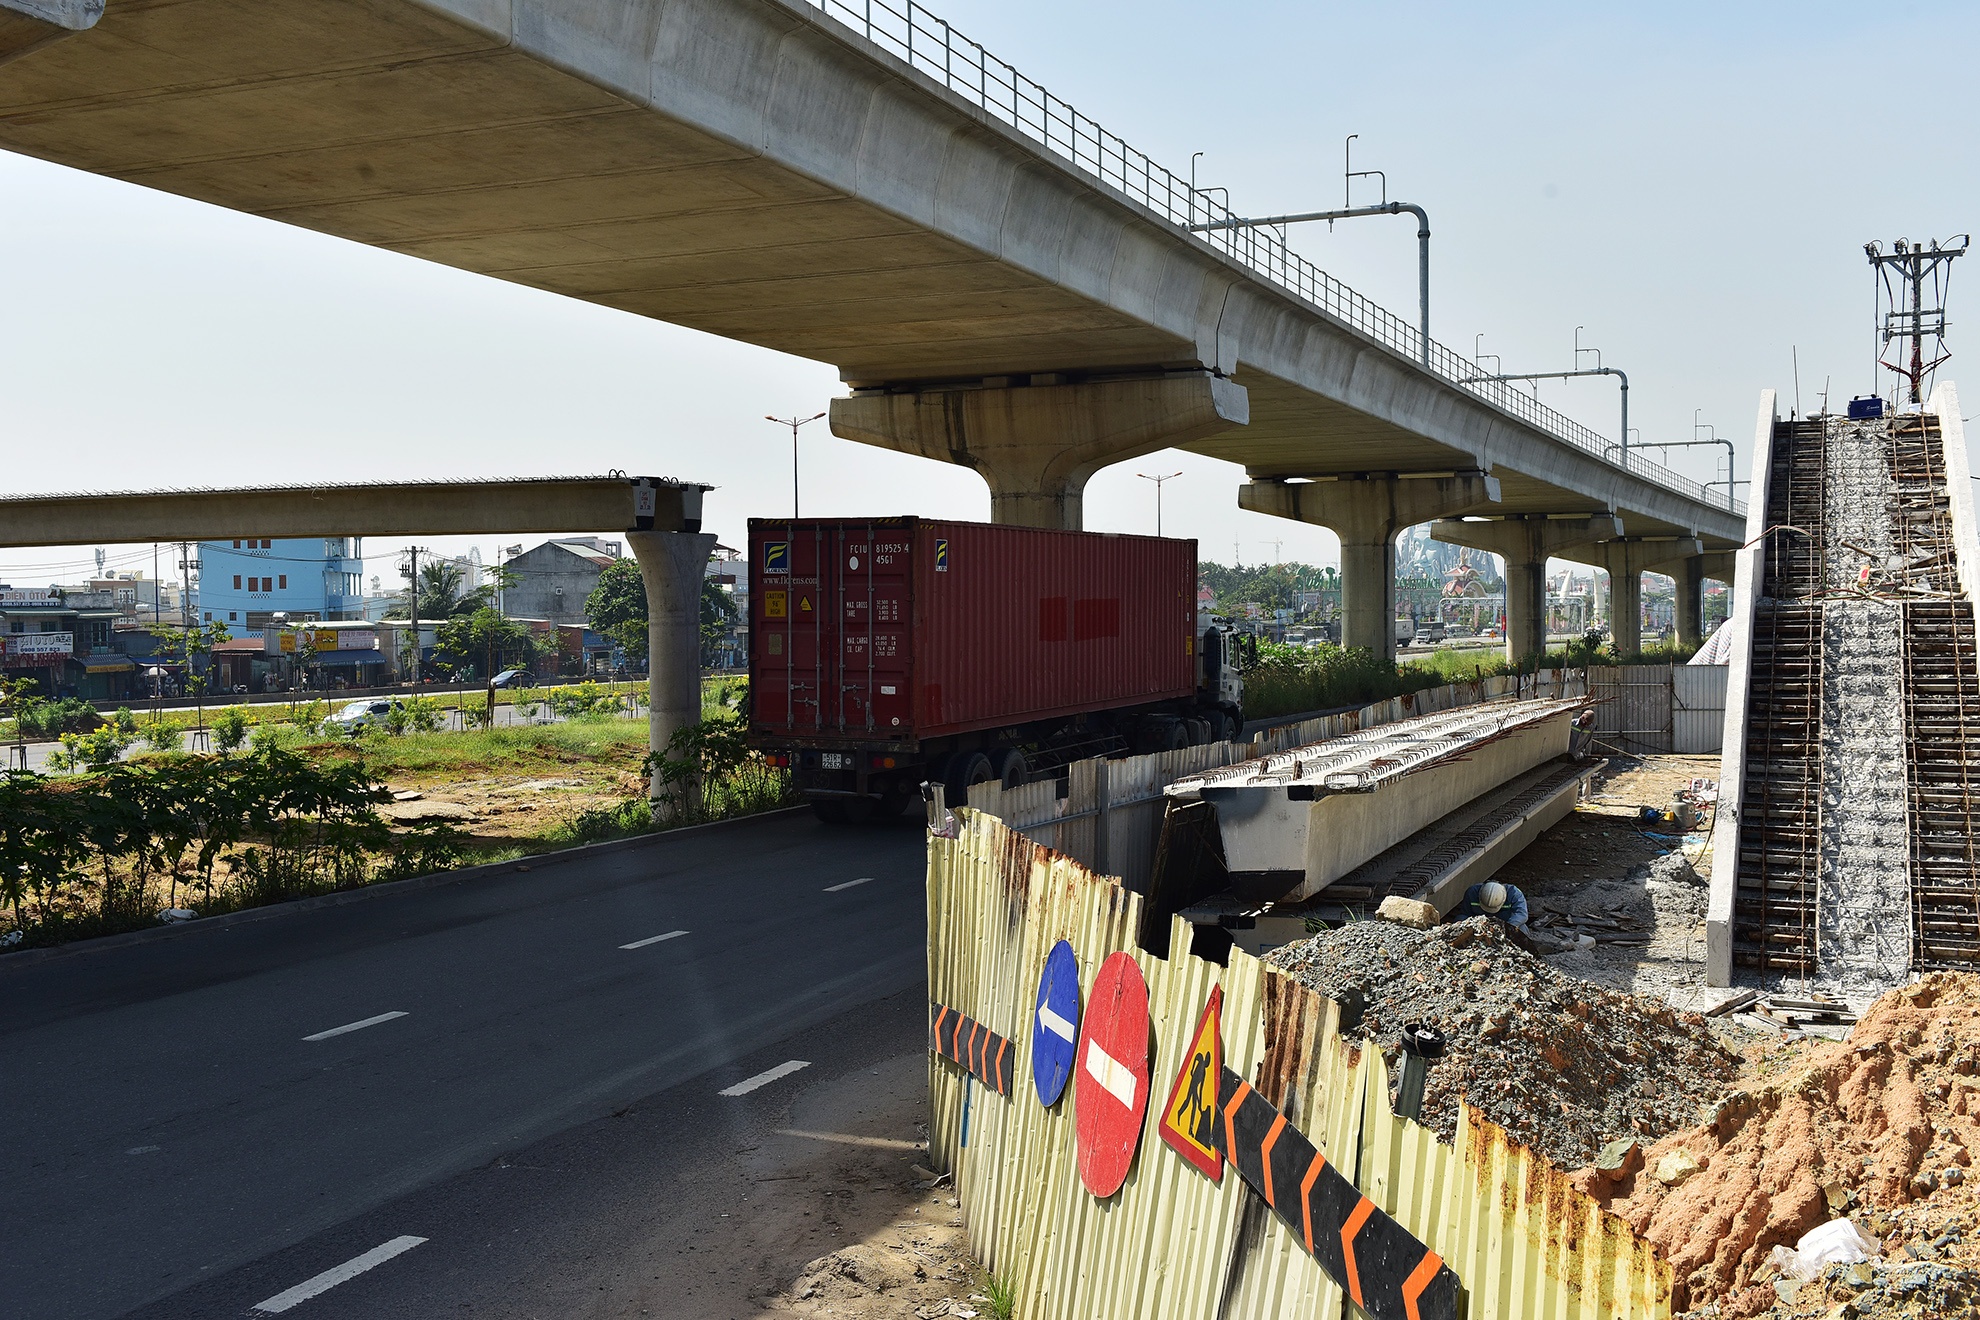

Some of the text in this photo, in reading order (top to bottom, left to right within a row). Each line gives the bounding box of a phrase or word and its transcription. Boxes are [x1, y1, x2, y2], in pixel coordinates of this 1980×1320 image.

[850, 545, 868, 554] FCIU
[876, 544, 902, 553] 819525
[876, 555, 893, 564] 45G1
